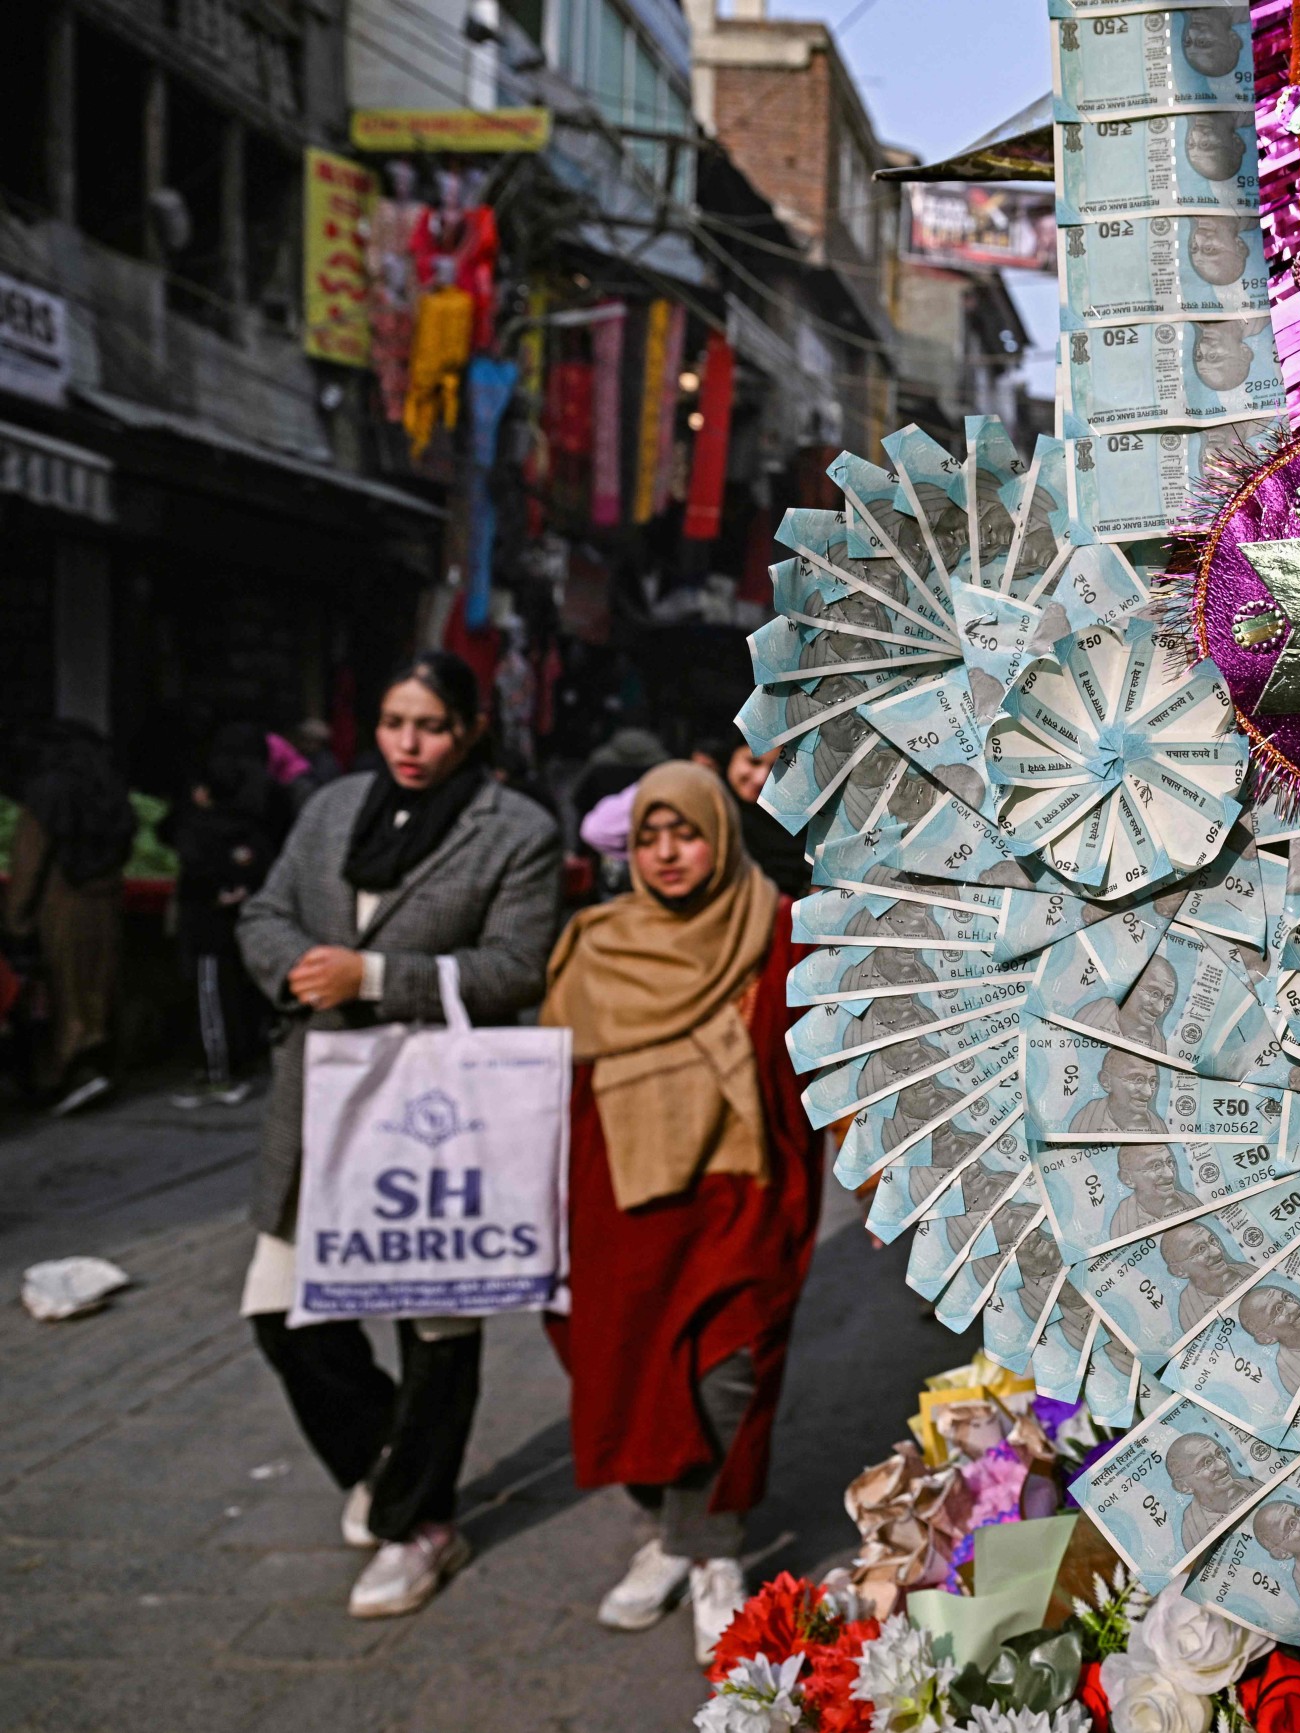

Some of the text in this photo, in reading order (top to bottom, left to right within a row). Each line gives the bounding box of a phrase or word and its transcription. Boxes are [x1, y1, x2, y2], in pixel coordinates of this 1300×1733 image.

[1109, 202, 1128, 210] BANK
[1130, 198, 1160, 207] RESERVE
[1099, 220, 1133, 239] ₹50
[1113, 306, 1132, 315] BANK
[1133, 304, 1164, 313] RESERVE
[1200, 301, 1224, 310] पचास
[1102, 327, 1138, 346] ₹50
[1086, 408, 1168, 424] RESERVE BANK OF INDIA
[1107, 434, 1143, 452] ₹50
[1077, 634, 1102, 651] ₹50
[1211, 681, 1230, 707] ₹50
[1148, 696, 1188, 728] पचास रुपये
[948, 715, 978, 762] 370491
[1166, 748, 1210, 759] पचास रुपये
[1205, 819, 1224, 844] ₹50
[1213, 1099, 1250, 1116] ₹50
[1232, 1145, 1270, 1170] ₹50
[372, 1166, 483, 1221] SH
[315, 1223, 539, 1265] FABRICS
[1118, 1238, 1157, 1277] 370560
[1210, 1317, 1236, 1365] 370559
[1091, 1462, 1118, 1488] भारतीय
[1121, 1449, 1163, 1493] 370575
[1227, 1532, 1253, 1586] 370574
